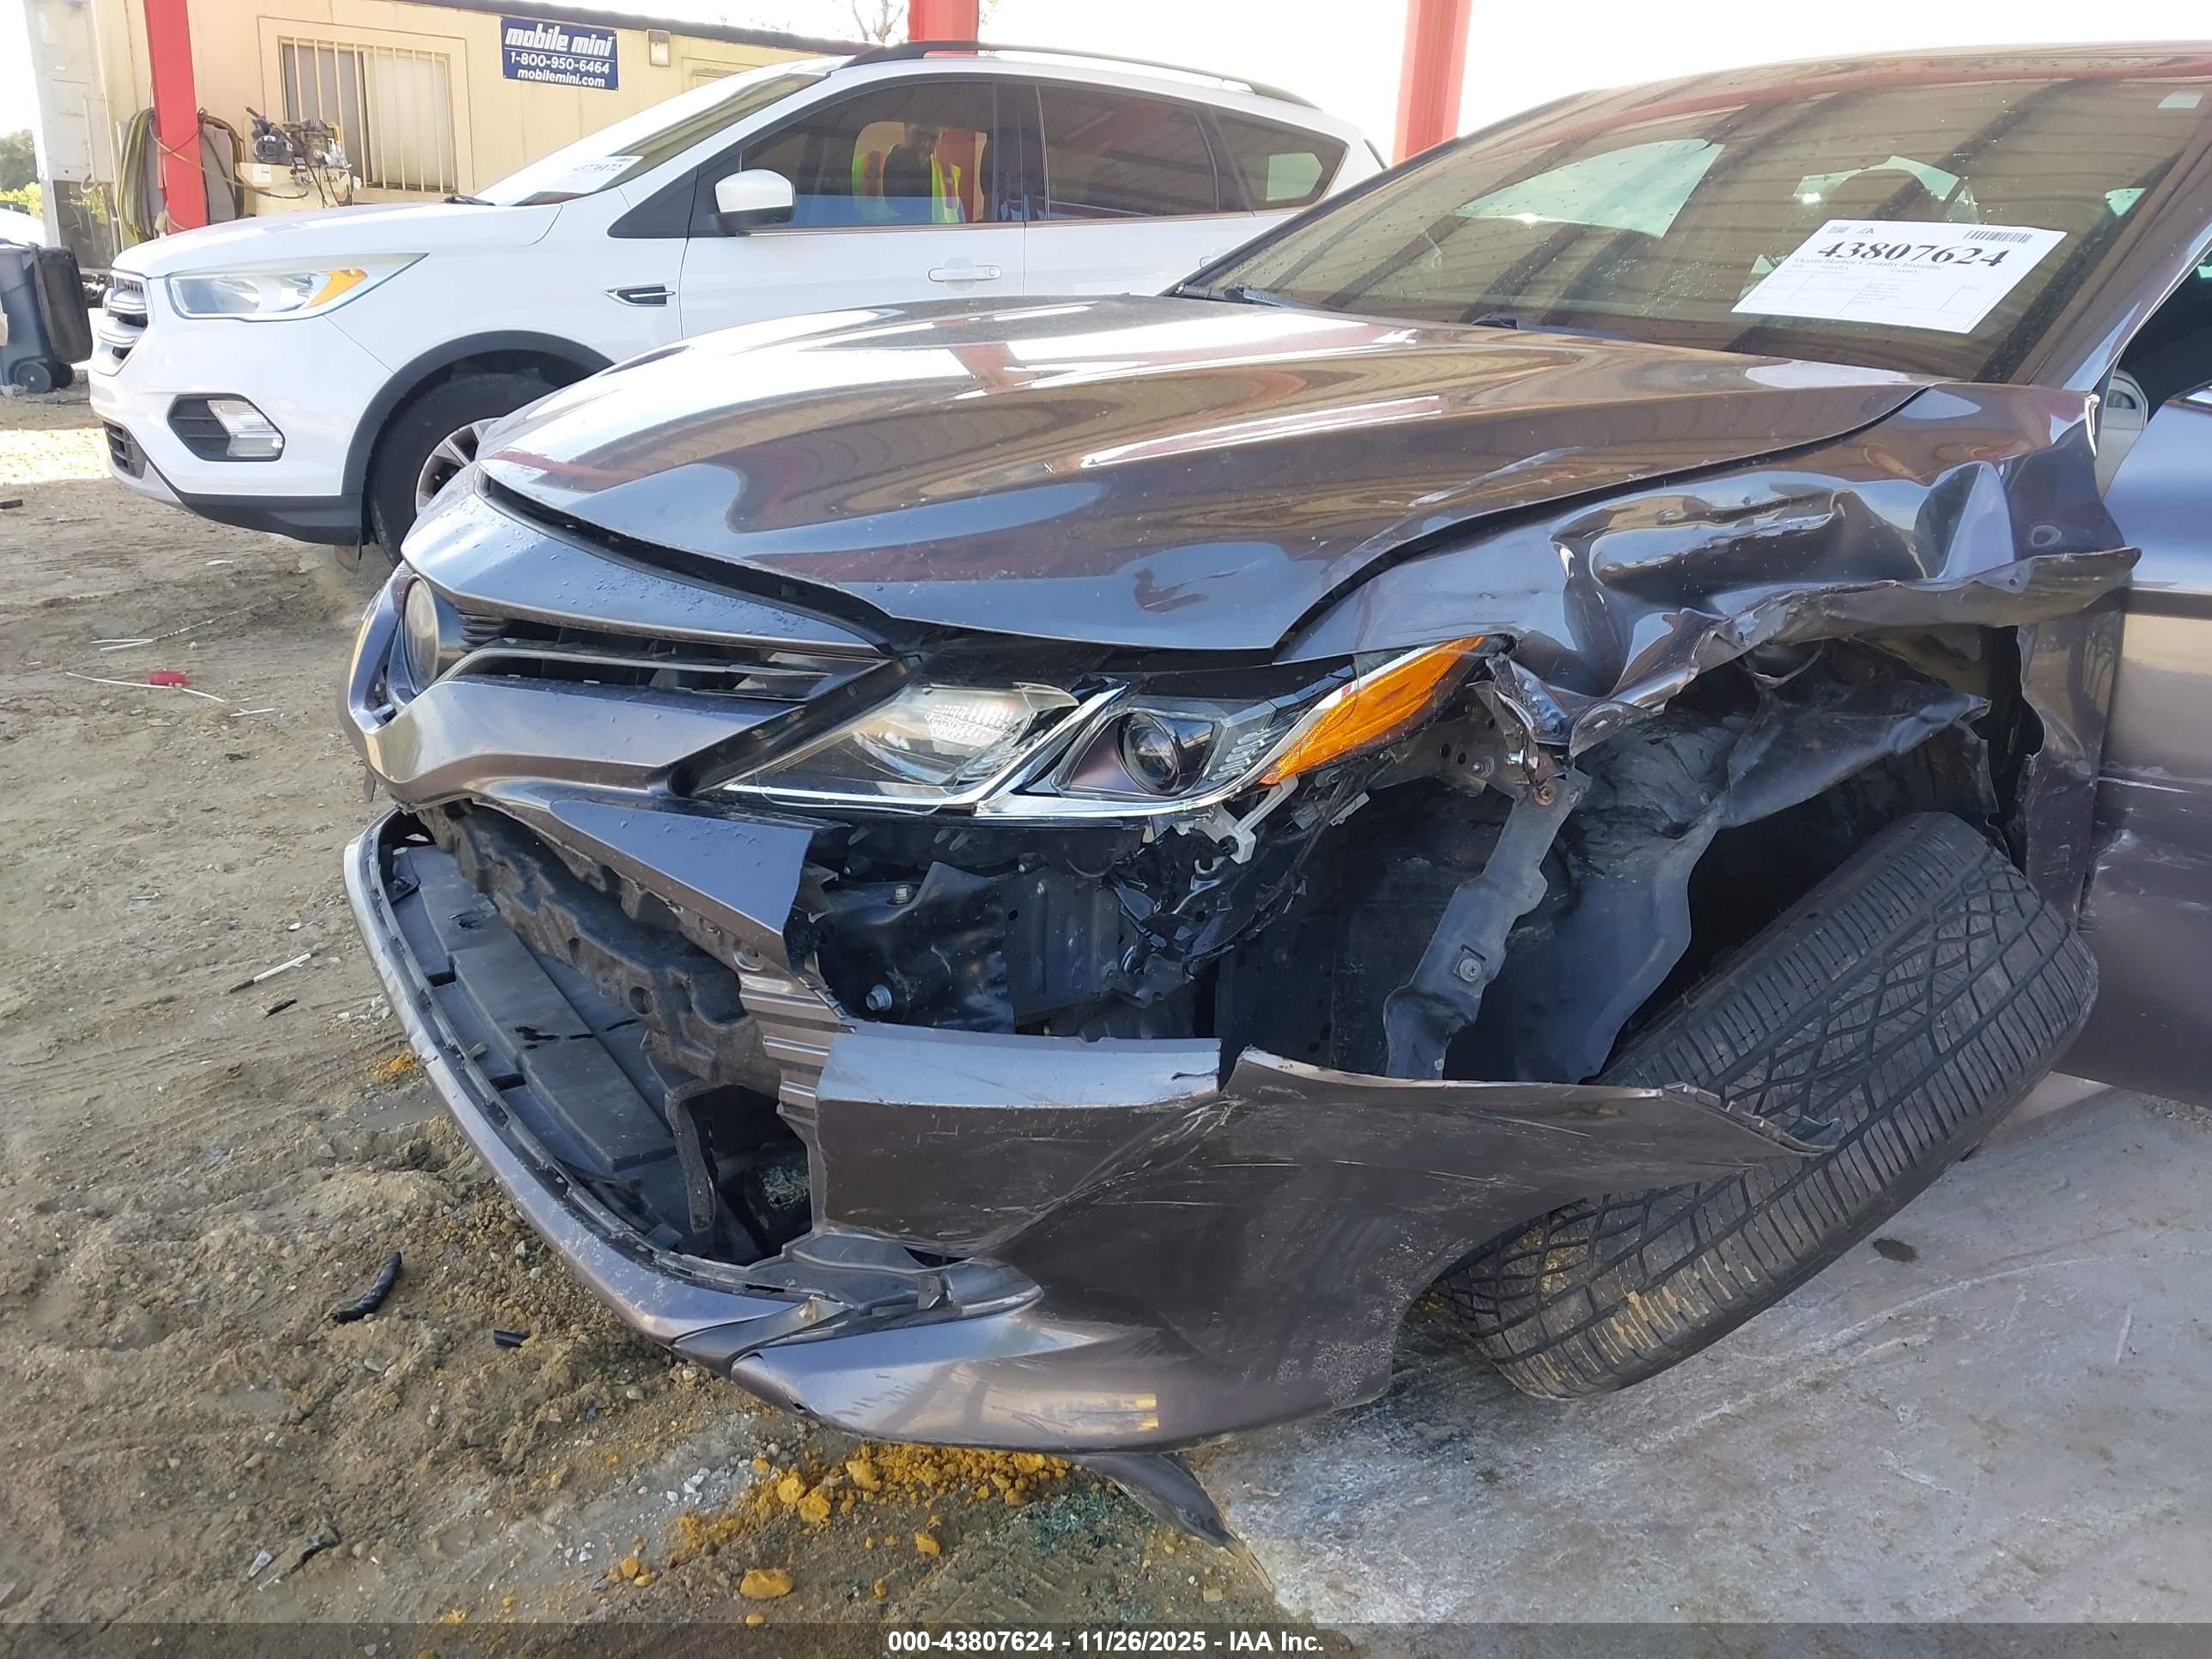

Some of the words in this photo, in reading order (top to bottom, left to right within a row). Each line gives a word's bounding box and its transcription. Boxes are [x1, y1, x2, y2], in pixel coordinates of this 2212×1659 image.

[505, 23, 569, 51] mobile
[571, 33, 613, 57] mini
[510, 52, 611, 75] 1-800-950-6464
[517, 69, 605, 88] mobilemini.com
[1817, 240, 2010, 267] 43807624
